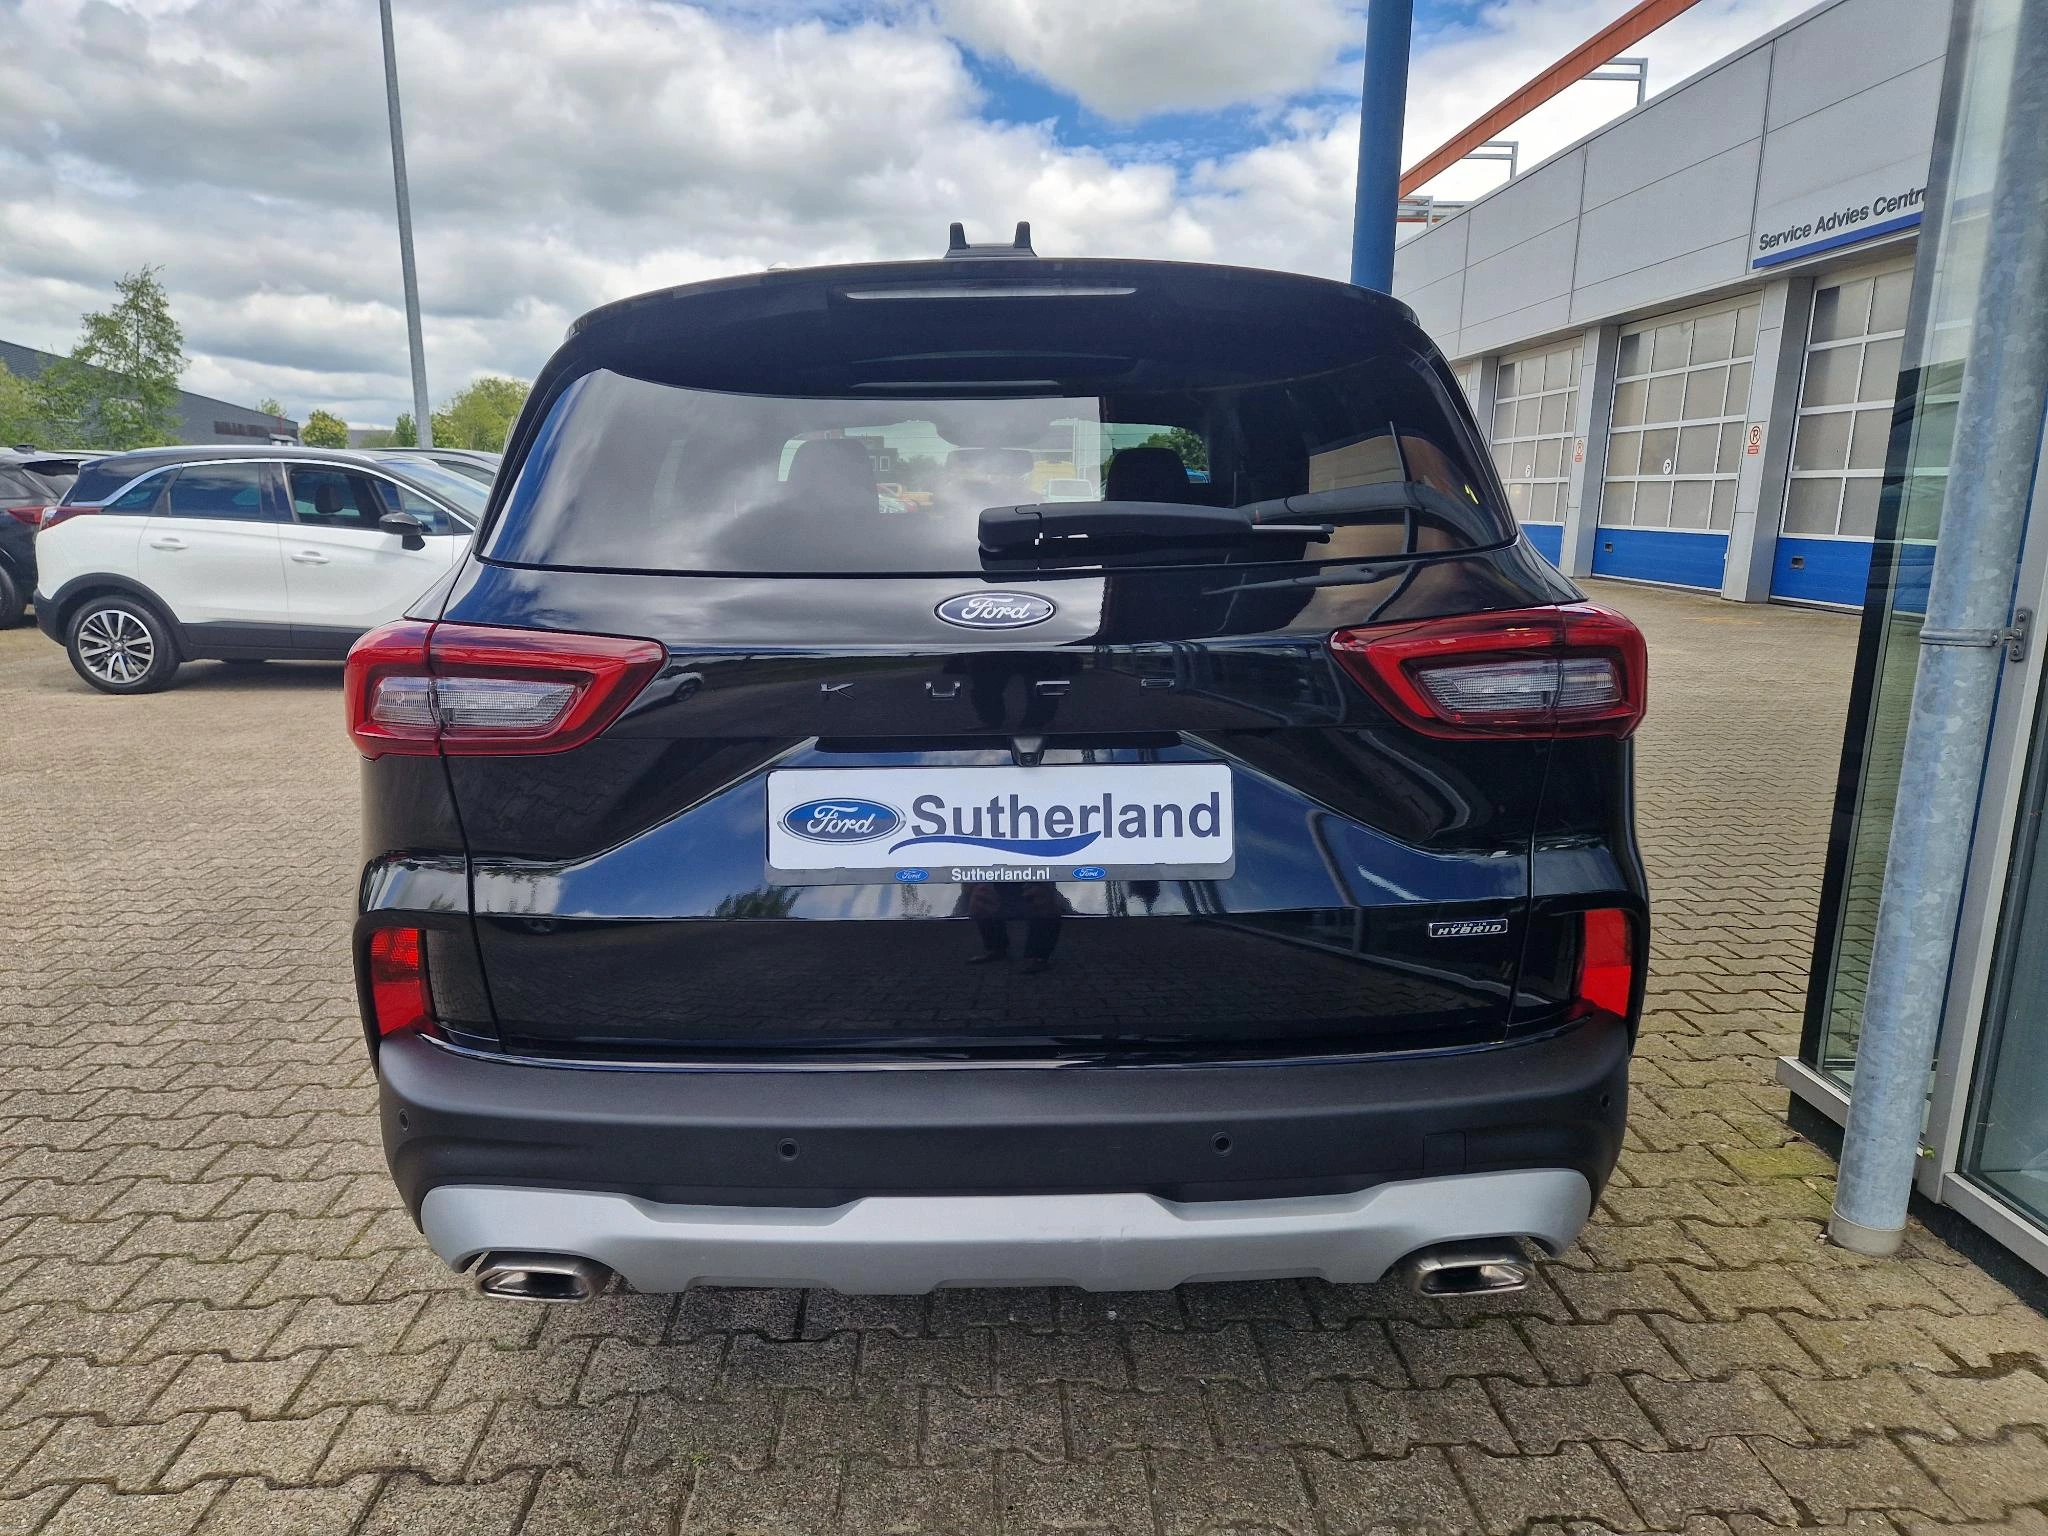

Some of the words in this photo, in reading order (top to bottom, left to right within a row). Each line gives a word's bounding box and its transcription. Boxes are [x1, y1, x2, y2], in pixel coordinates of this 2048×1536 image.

[1759, 224, 1812, 251] Service
[1814, 205, 1870, 235] Advies
[1873, 187, 1926, 216] Centr
[961, 597, 1031, 620] Ford
[806, 805, 876, 835] Ford
[911, 791, 1220, 839] Sutherland
[951, 866, 1050, 882] Sutherland.nl
[1437, 924, 1501, 935] HYBRID
